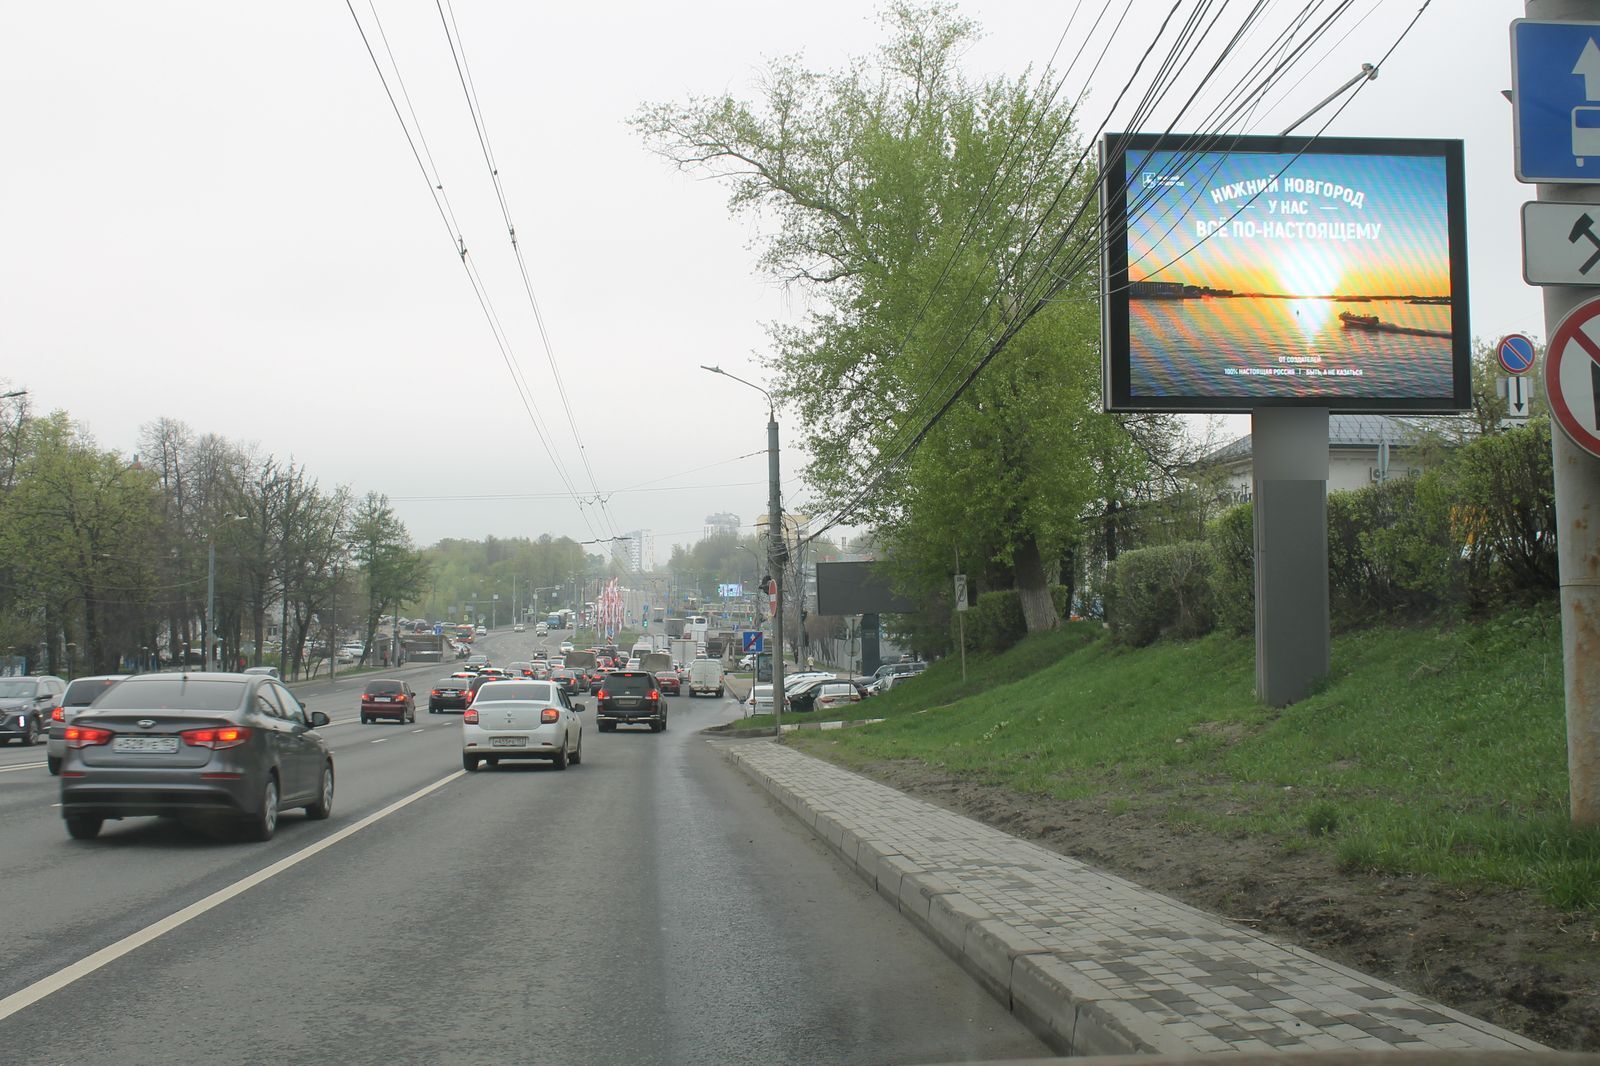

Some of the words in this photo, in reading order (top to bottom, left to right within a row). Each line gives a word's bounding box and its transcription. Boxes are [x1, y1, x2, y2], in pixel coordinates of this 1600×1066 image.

[1210, 174, 1279, 204] НИЖНИЙ
[1284, 177, 1365, 210] НОВГОРОД
[1268, 200, 1278, 214] У
[1280, 200, 1309, 215] НАС
[1195, 216, 1229, 238] ВСЁ
[1232, 220, 1382, 241] ПО-НАСТОЯЩЕМУ
[1286, 354, 1322, 363] СОЗДАТЕЛЕЙ
[1239, 368, 1273, 376] НАСТОЯЩАЯ
